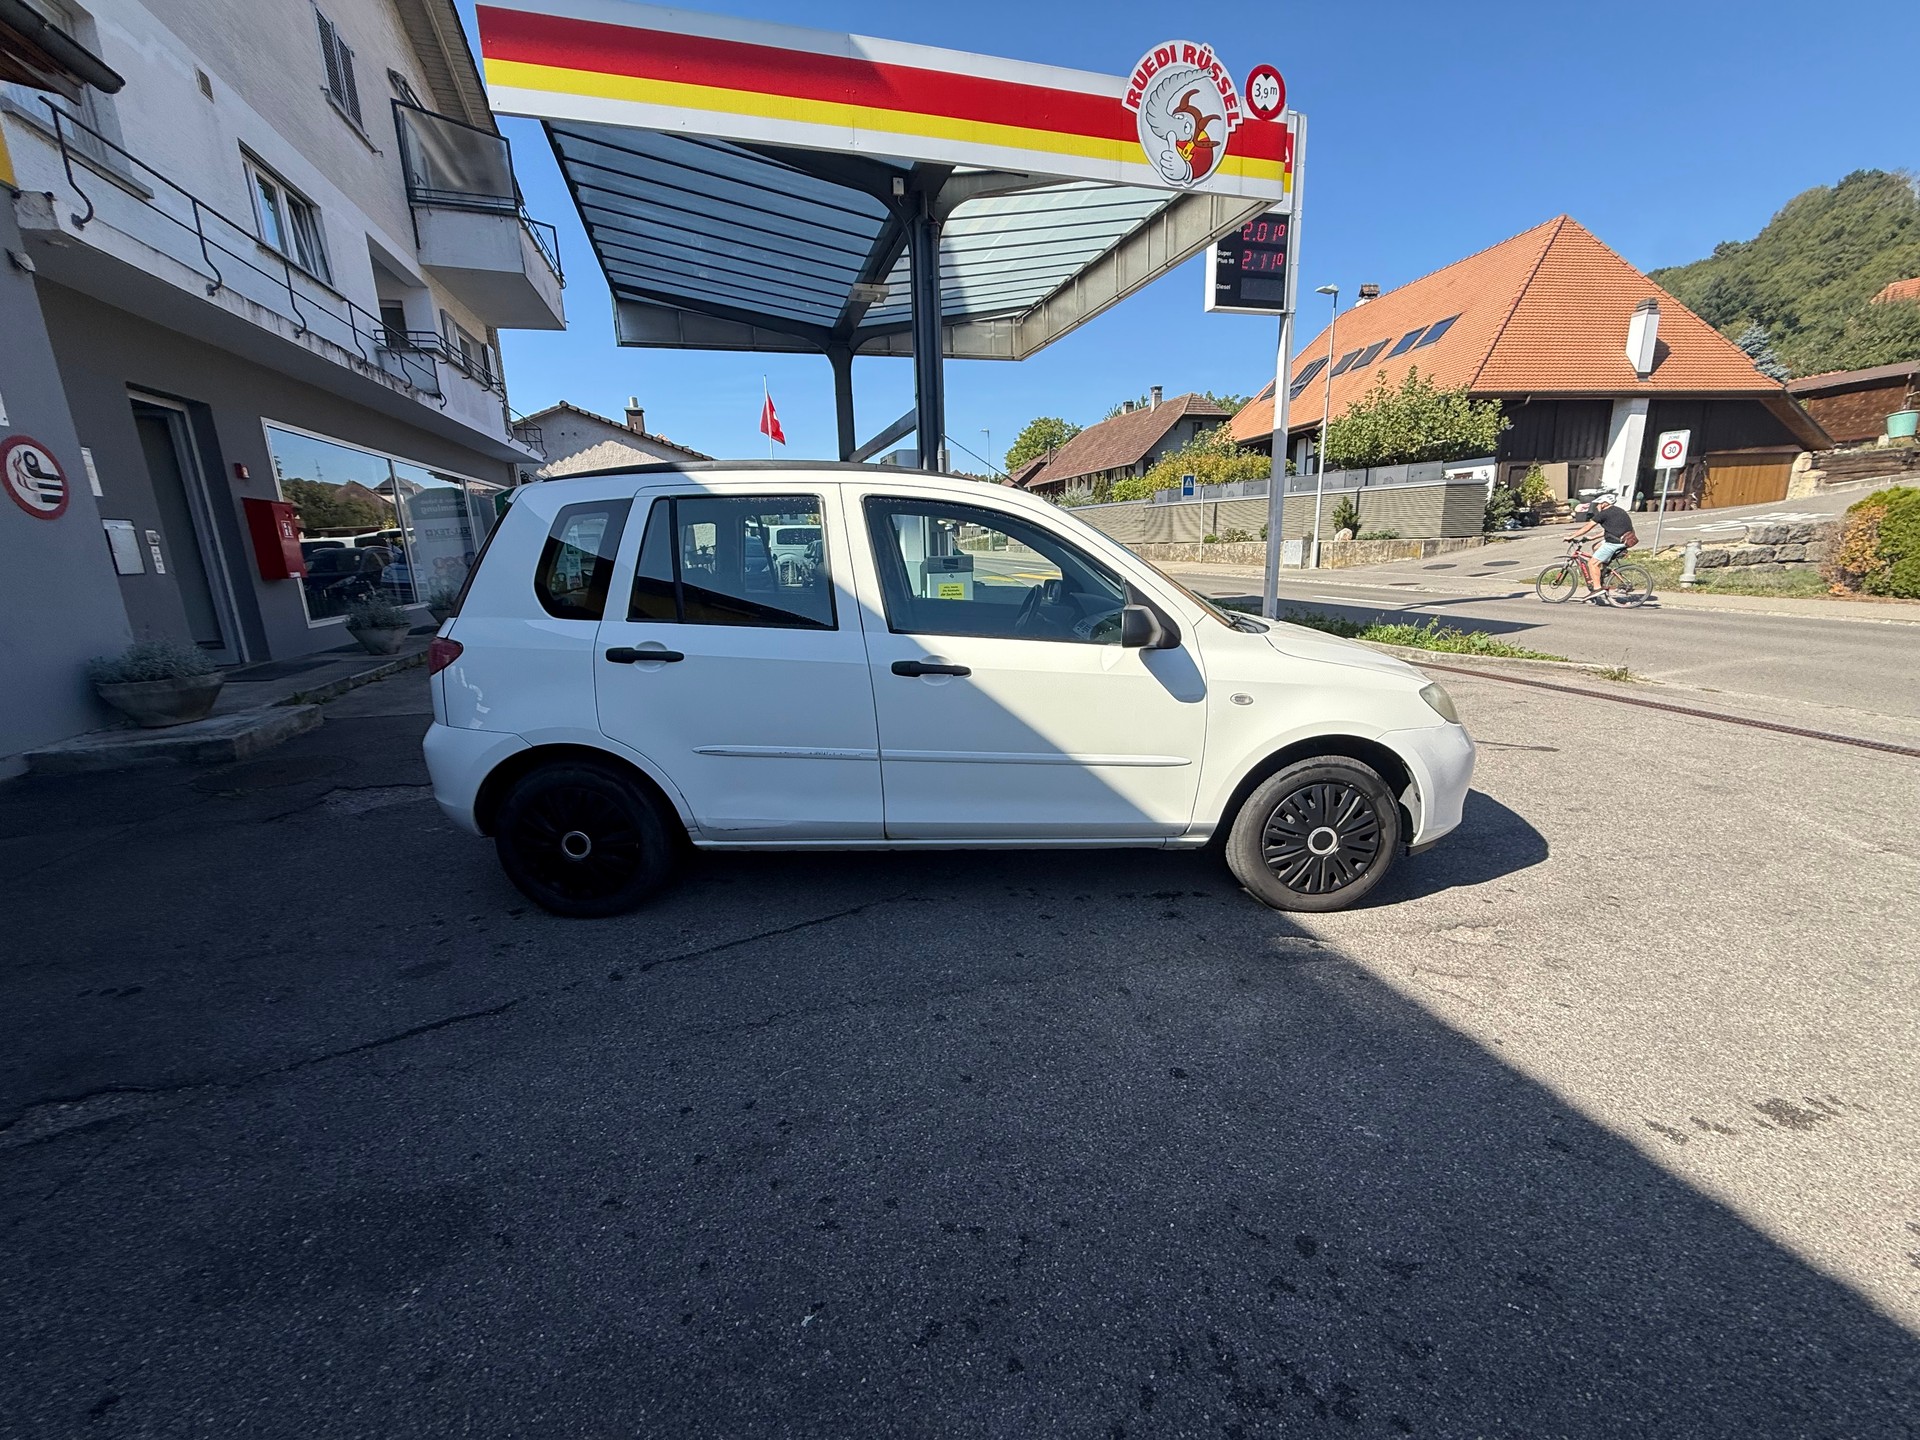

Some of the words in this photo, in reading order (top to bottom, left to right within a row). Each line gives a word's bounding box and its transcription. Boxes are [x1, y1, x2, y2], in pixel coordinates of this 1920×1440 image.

[1126, 45, 1177, 109] RUEDI
[1183, 44, 1240, 127] RÜSSEL
[1668, 446, 1677, 454] 30
